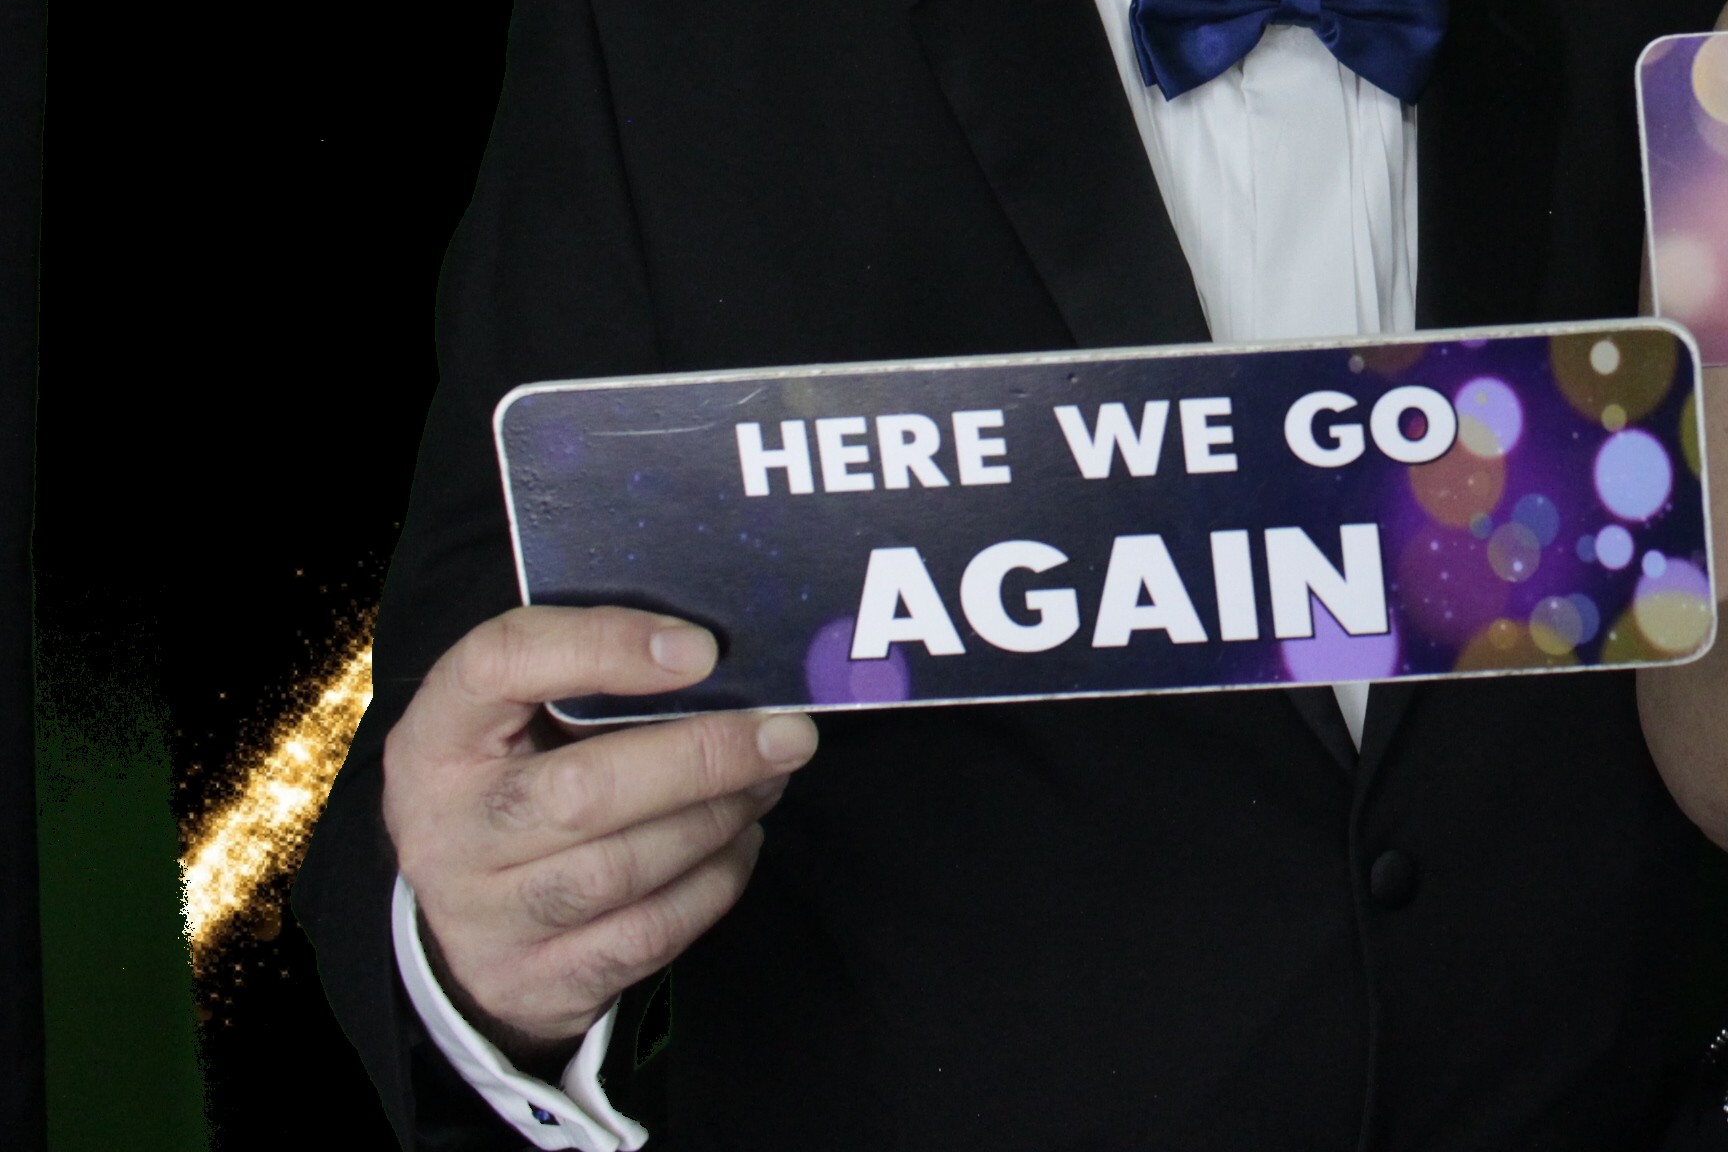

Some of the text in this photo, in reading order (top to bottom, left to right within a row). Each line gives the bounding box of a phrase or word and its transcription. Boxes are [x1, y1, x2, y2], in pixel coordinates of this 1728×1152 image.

[734, 385, 1460, 498] HERE WE GO
[848, 523, 1391, 662] AGAIN
